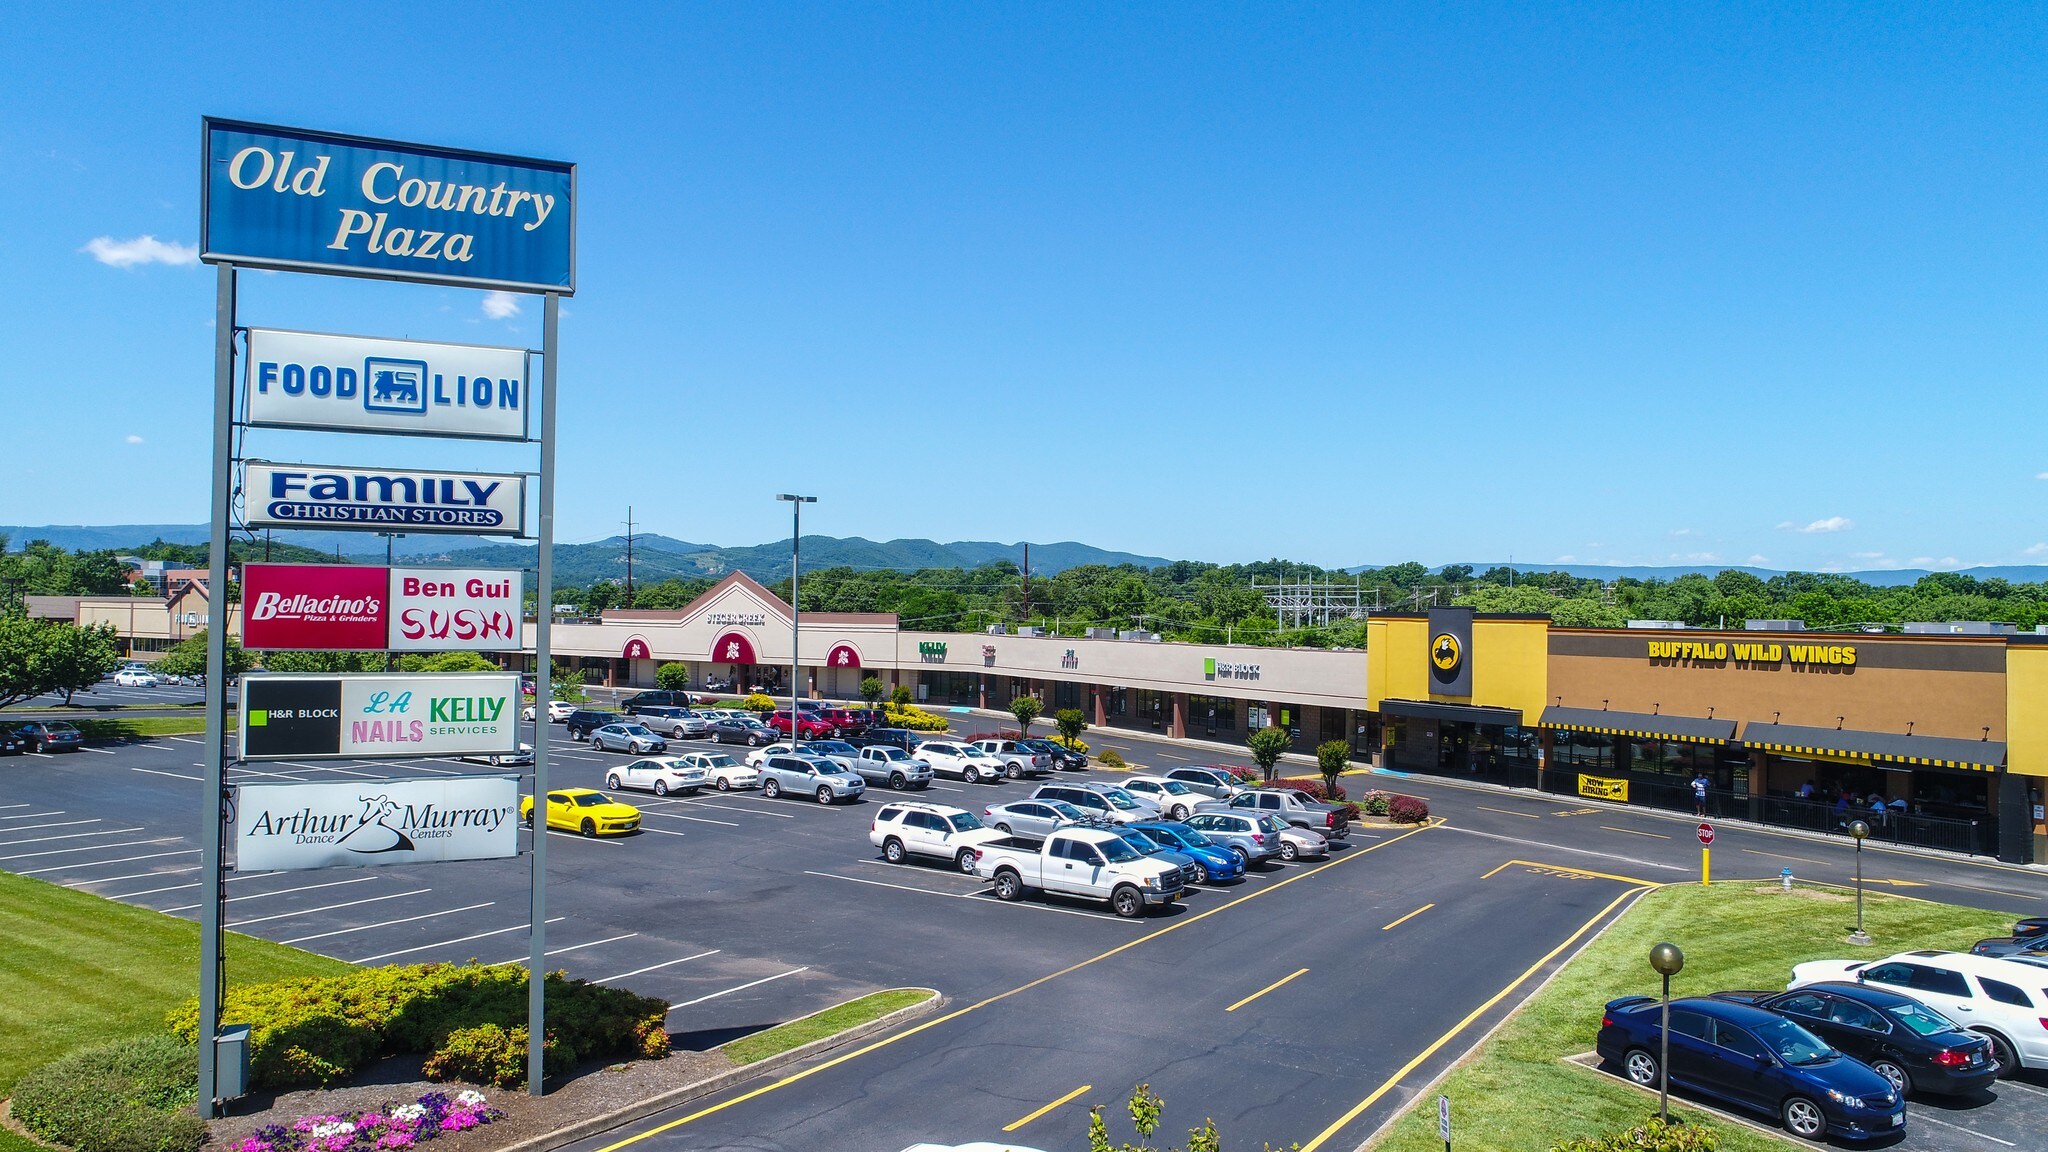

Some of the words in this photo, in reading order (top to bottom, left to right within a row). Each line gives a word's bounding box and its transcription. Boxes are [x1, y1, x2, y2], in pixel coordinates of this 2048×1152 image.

[229, 147, 331, 197] Old
[361, 162, 555, 231] Country
[326, 208, 475, 262] Plaza
[258, 362, 358, 398] FOOD
[434, 374, 519, 408] LION
[274, 503, 406, 521] CHRISTIAN
[411, 509, 497, 525] STORES
[403, 577, 455, 597] Ben
[465, 578, 510, 598] Gui
[251, 592, 380, 620] Bellacino's
[303, 614, 327, 622] Pizza
[329, 614, 336, 622] &
[338, 614, 378, 623] Grinders
[400, 607, 514, 641] SUSHI
[1648, 641, 1727, 659] BUFFALO
[1732, 643, 1782, 662] WILD
[1788, 645, 1856, 664] WINGS
[268, 709, 293, 719] H&R
[298, 708, 338, 719] BLOCK
[363, 690, 412, 714] LA
[430, 696, 506, 723] KELLY
[352, 719, 424, 744] NAILS
[430, 726, 497, 735] SERVICES
[1582, 785, 1609, 797] HIRING
[246, 807, 353, 837] Arthur
[1698, 828, 1713, 839] STOP
[295, 833, 335, 845] Dance
[410, 828, 453, 840] Centers
[1526, 867, 1596, 880] STOP
